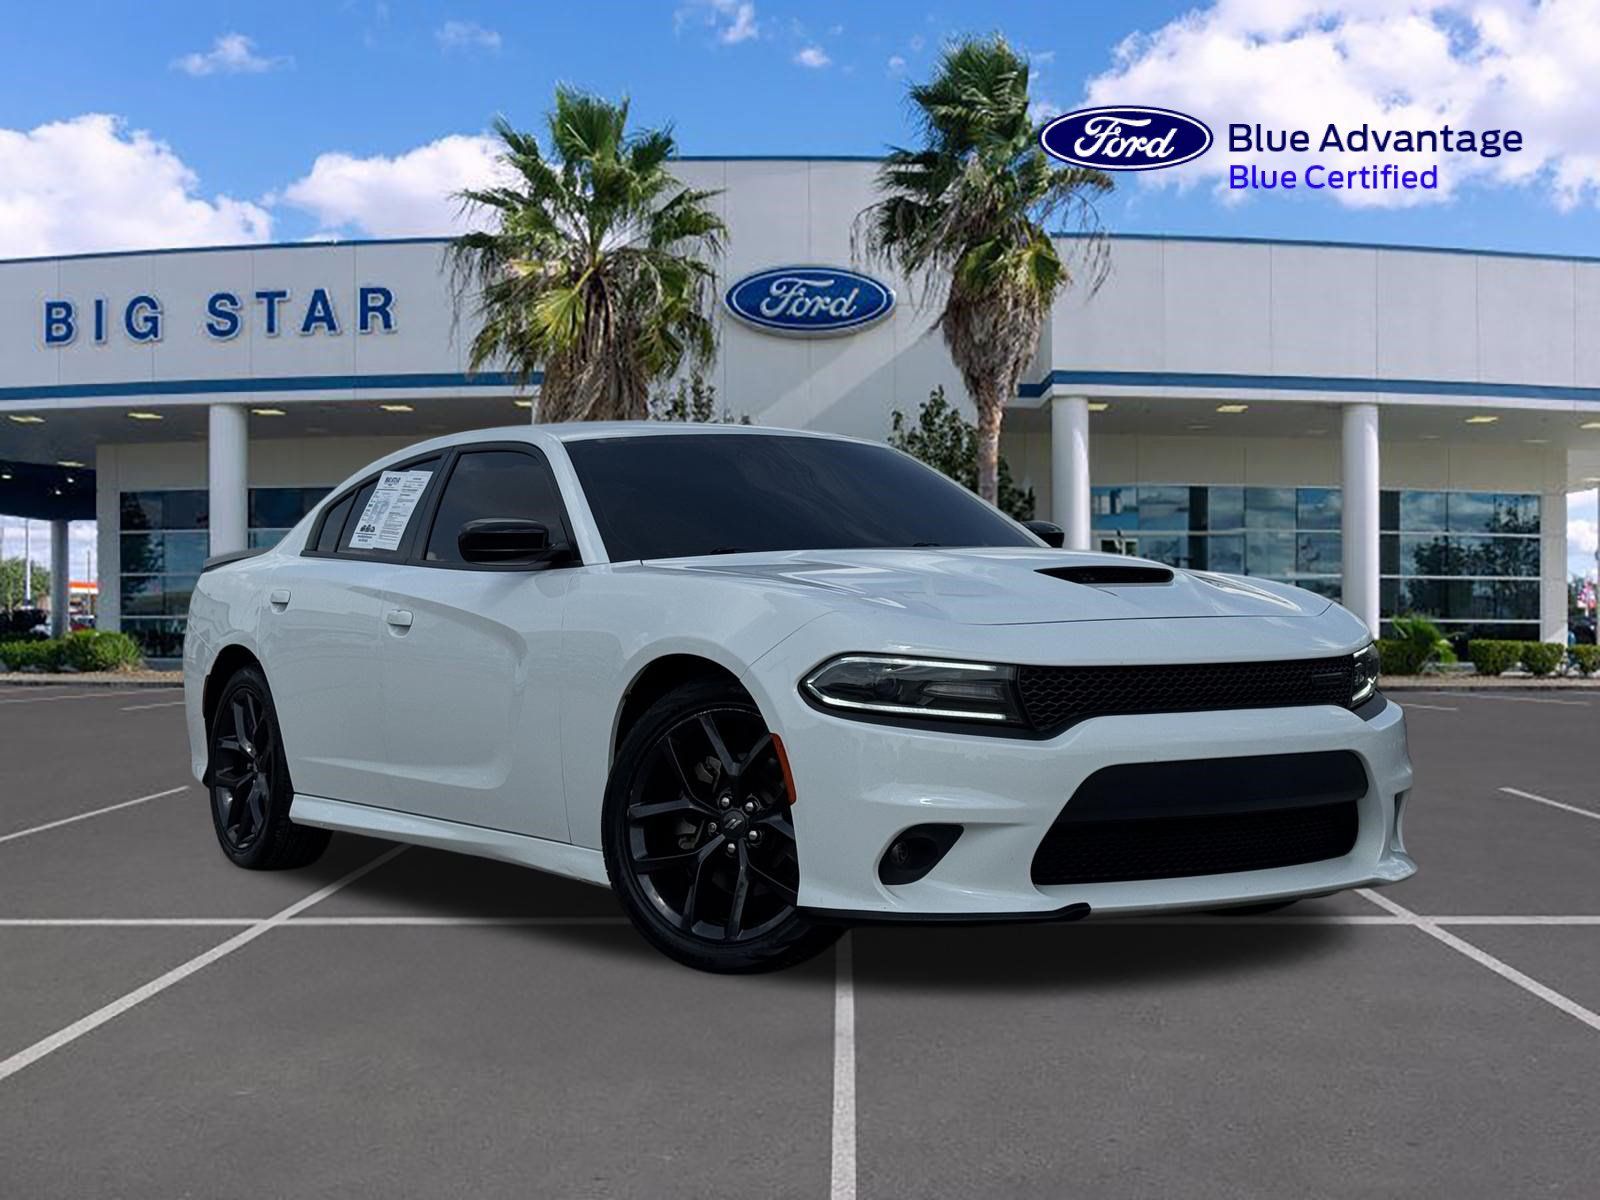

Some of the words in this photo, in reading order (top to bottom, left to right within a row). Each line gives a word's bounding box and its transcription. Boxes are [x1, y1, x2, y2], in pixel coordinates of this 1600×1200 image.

[44, 295, 162, 344] BIG
[206, 286, 396, 338] STAR
[760, 277, 859, 317] Ford
